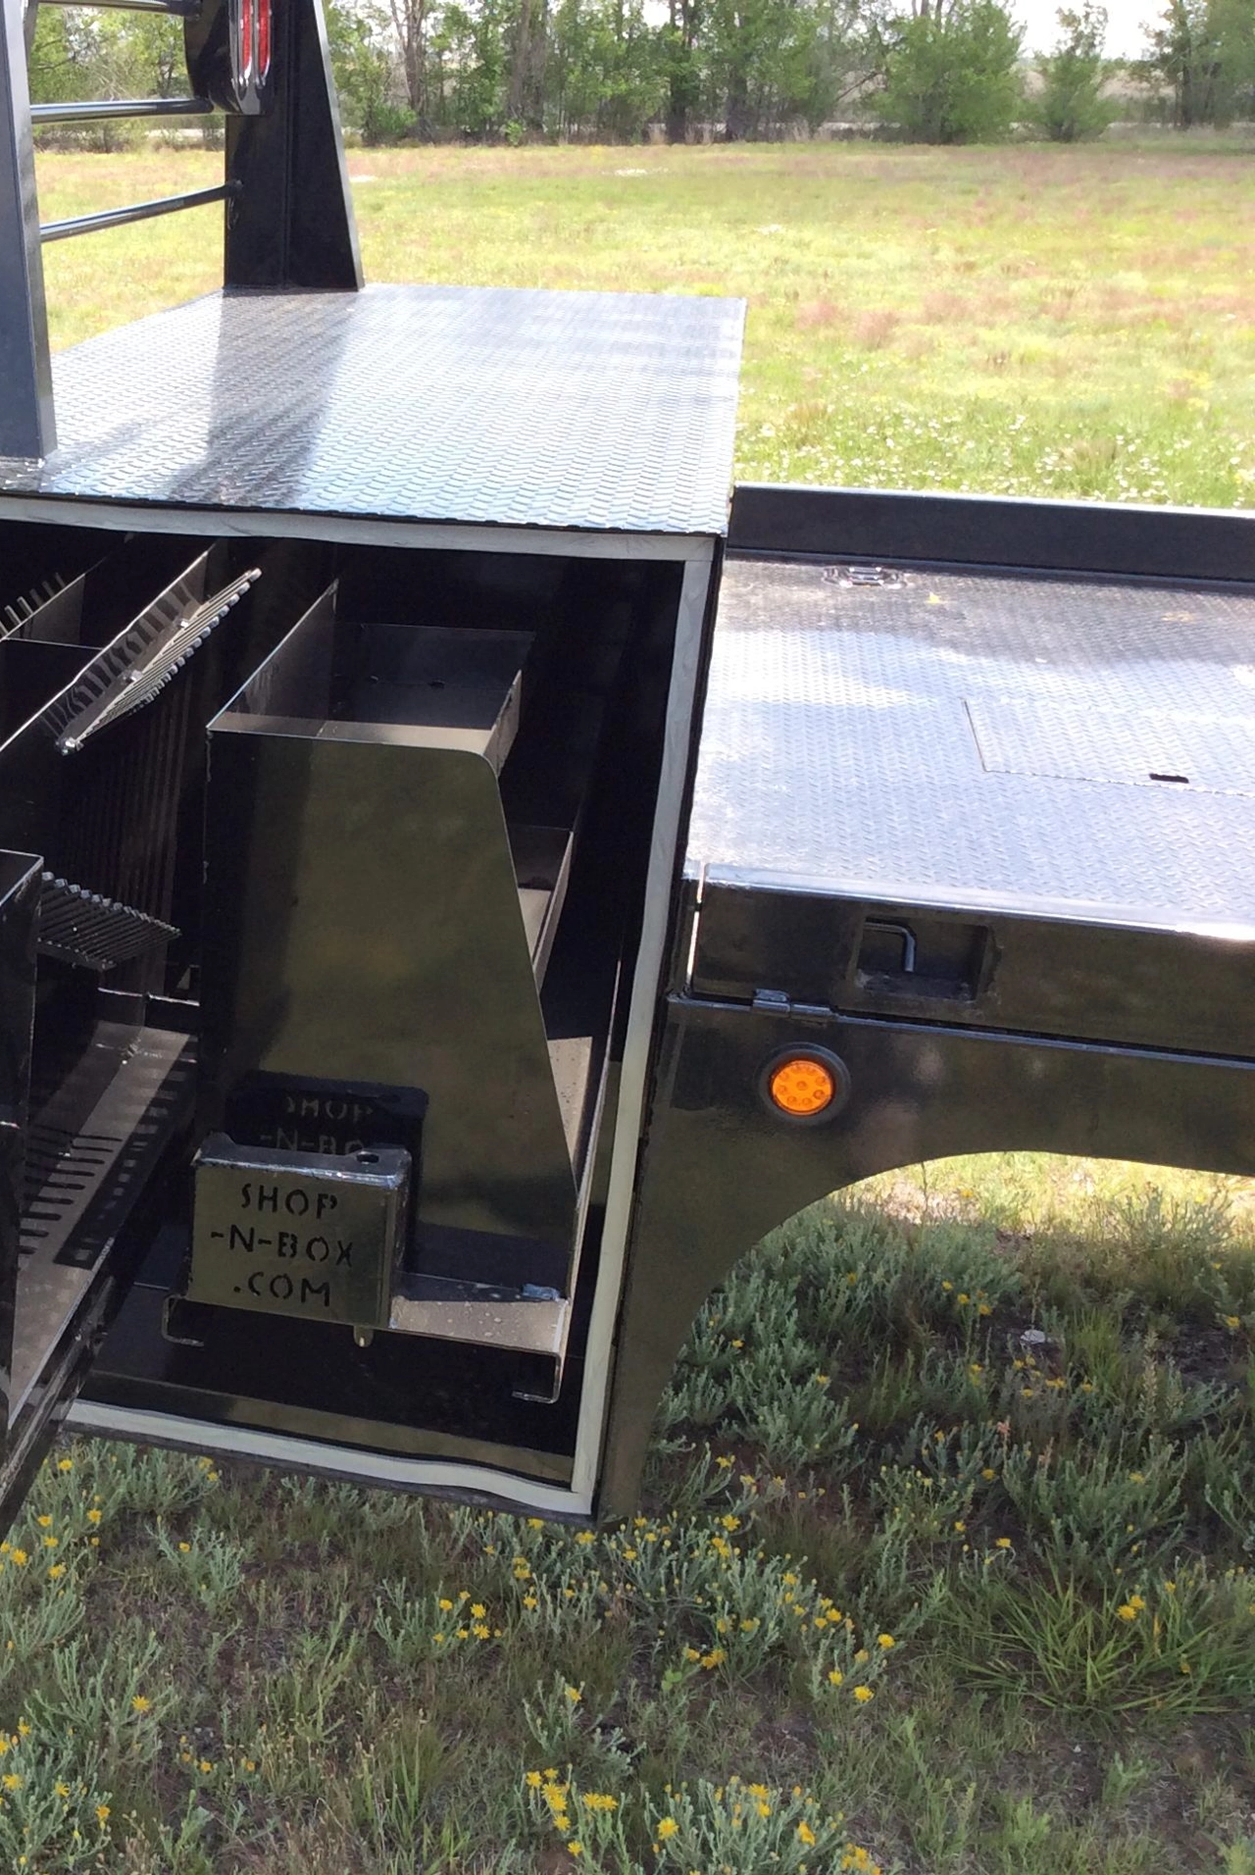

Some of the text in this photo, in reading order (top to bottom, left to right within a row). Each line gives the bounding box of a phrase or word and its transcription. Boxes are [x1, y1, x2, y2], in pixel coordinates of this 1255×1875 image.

[241, 1183, 338, 1219] SHOP
[210, 1224, 353, 1267] -N-BOX
[233, 1271, 331, 1307] .COM
